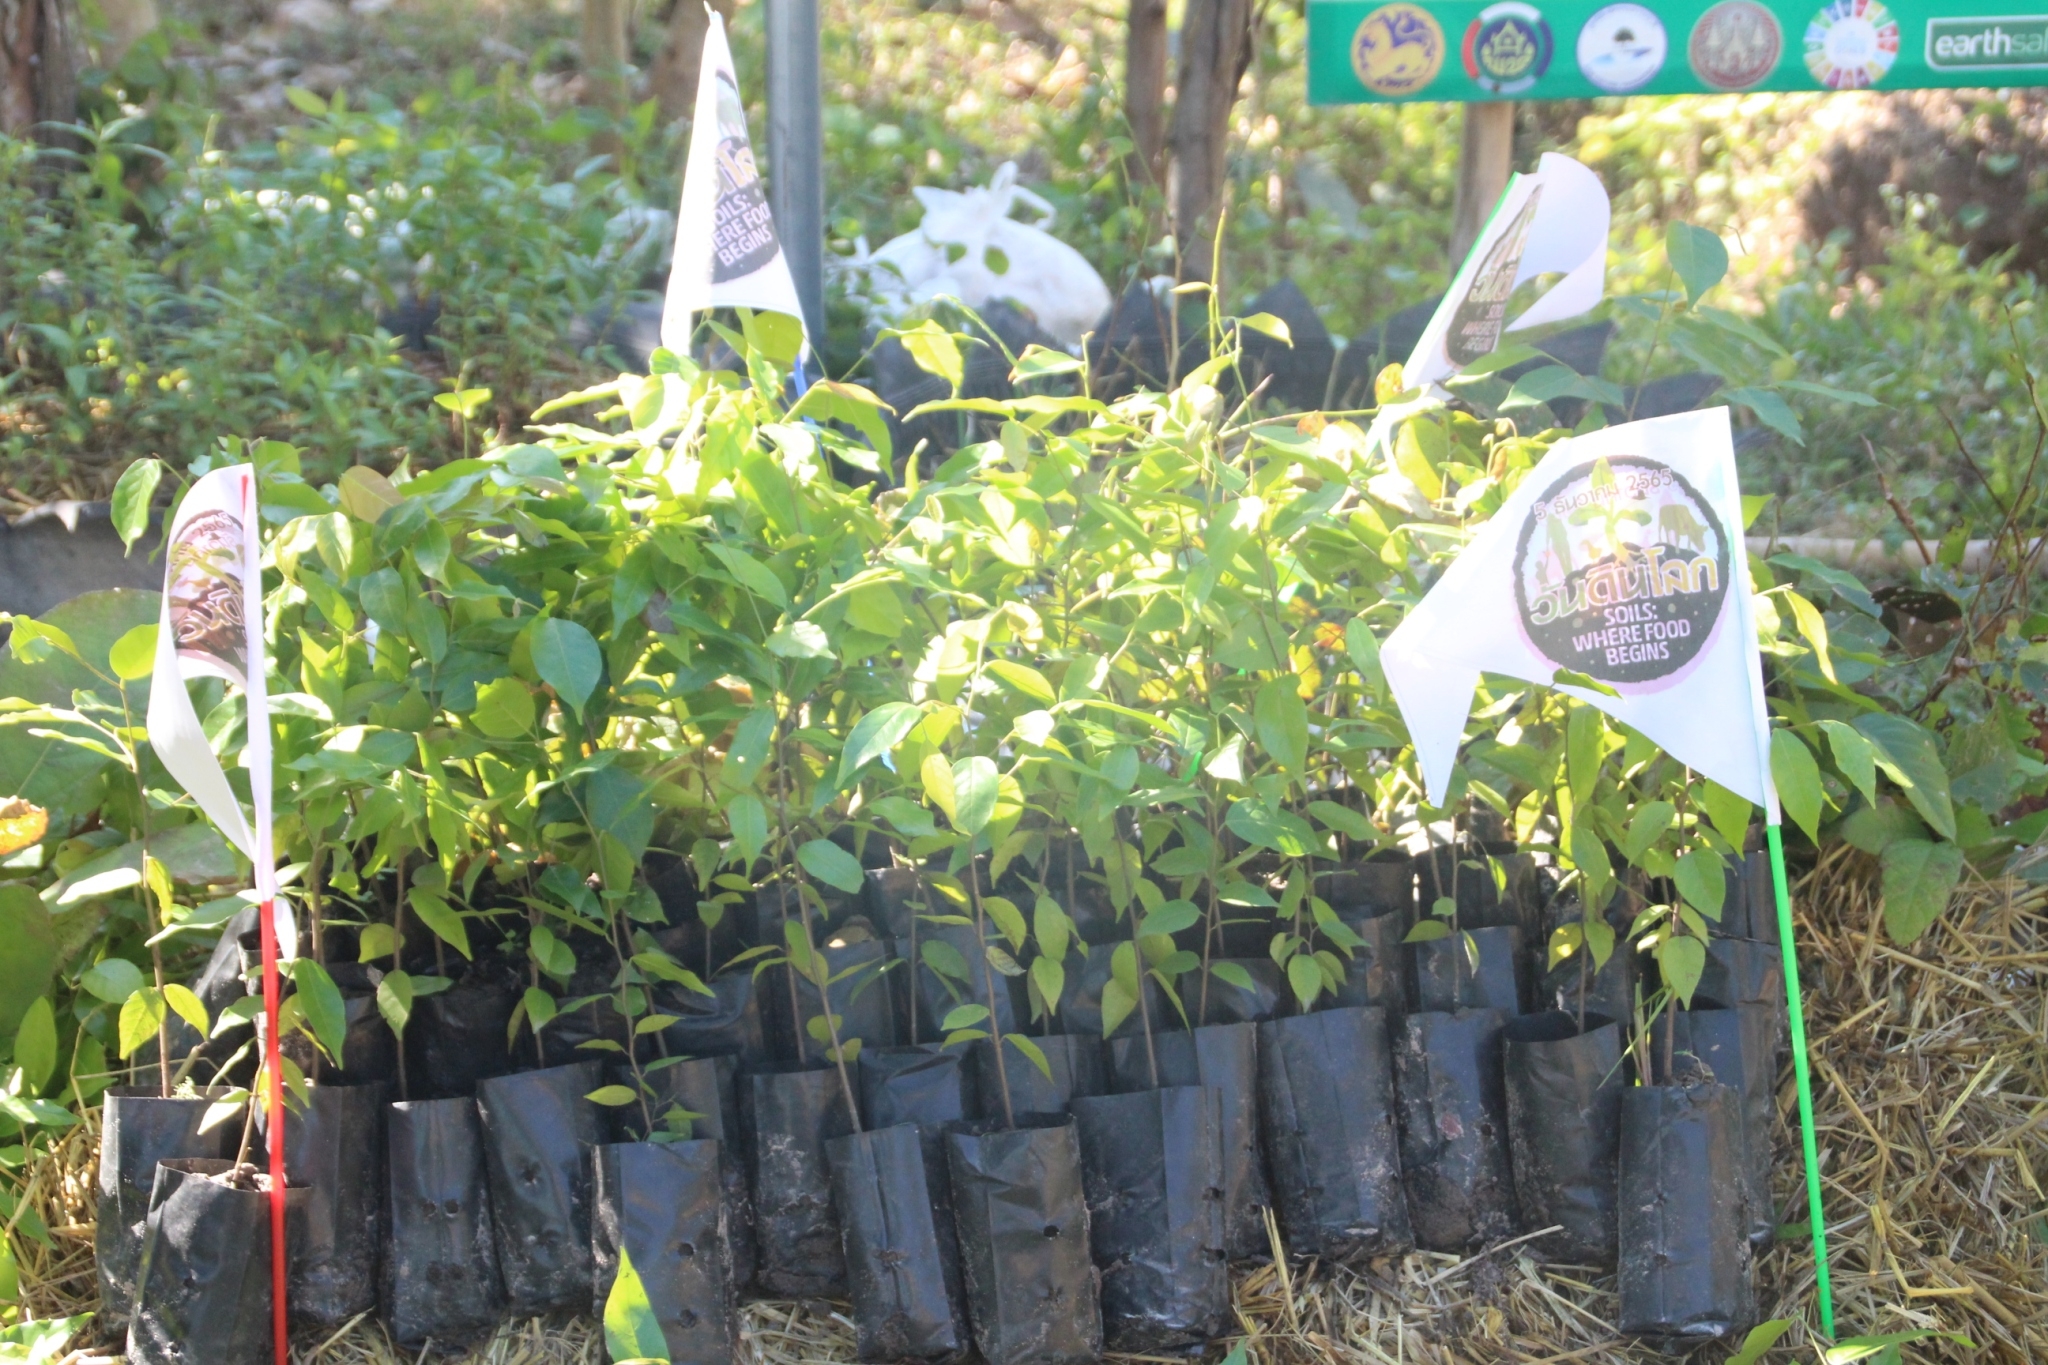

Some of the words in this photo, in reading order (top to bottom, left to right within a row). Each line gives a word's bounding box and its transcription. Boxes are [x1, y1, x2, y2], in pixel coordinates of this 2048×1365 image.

[1935, 26, 2048, 57] earthsa
[713, 194, 752, 226] OILS:
[718, 224, 773, 267] BEGINS
[1533, 502, 1548, 520] 5
[1554, 483, 1620, 515] ธันวาคม
[1626, 468, 1673, 491] 2565
[1530, 546, 1719, 625] วันดินโลก
[1604, 604, 1658, 626] SOILS:
[1572, 625, 1641, 652] WHERE
[1644, 619, 1691, 640] FOOD
[1605, 641, 1670, 666] BEGINS
